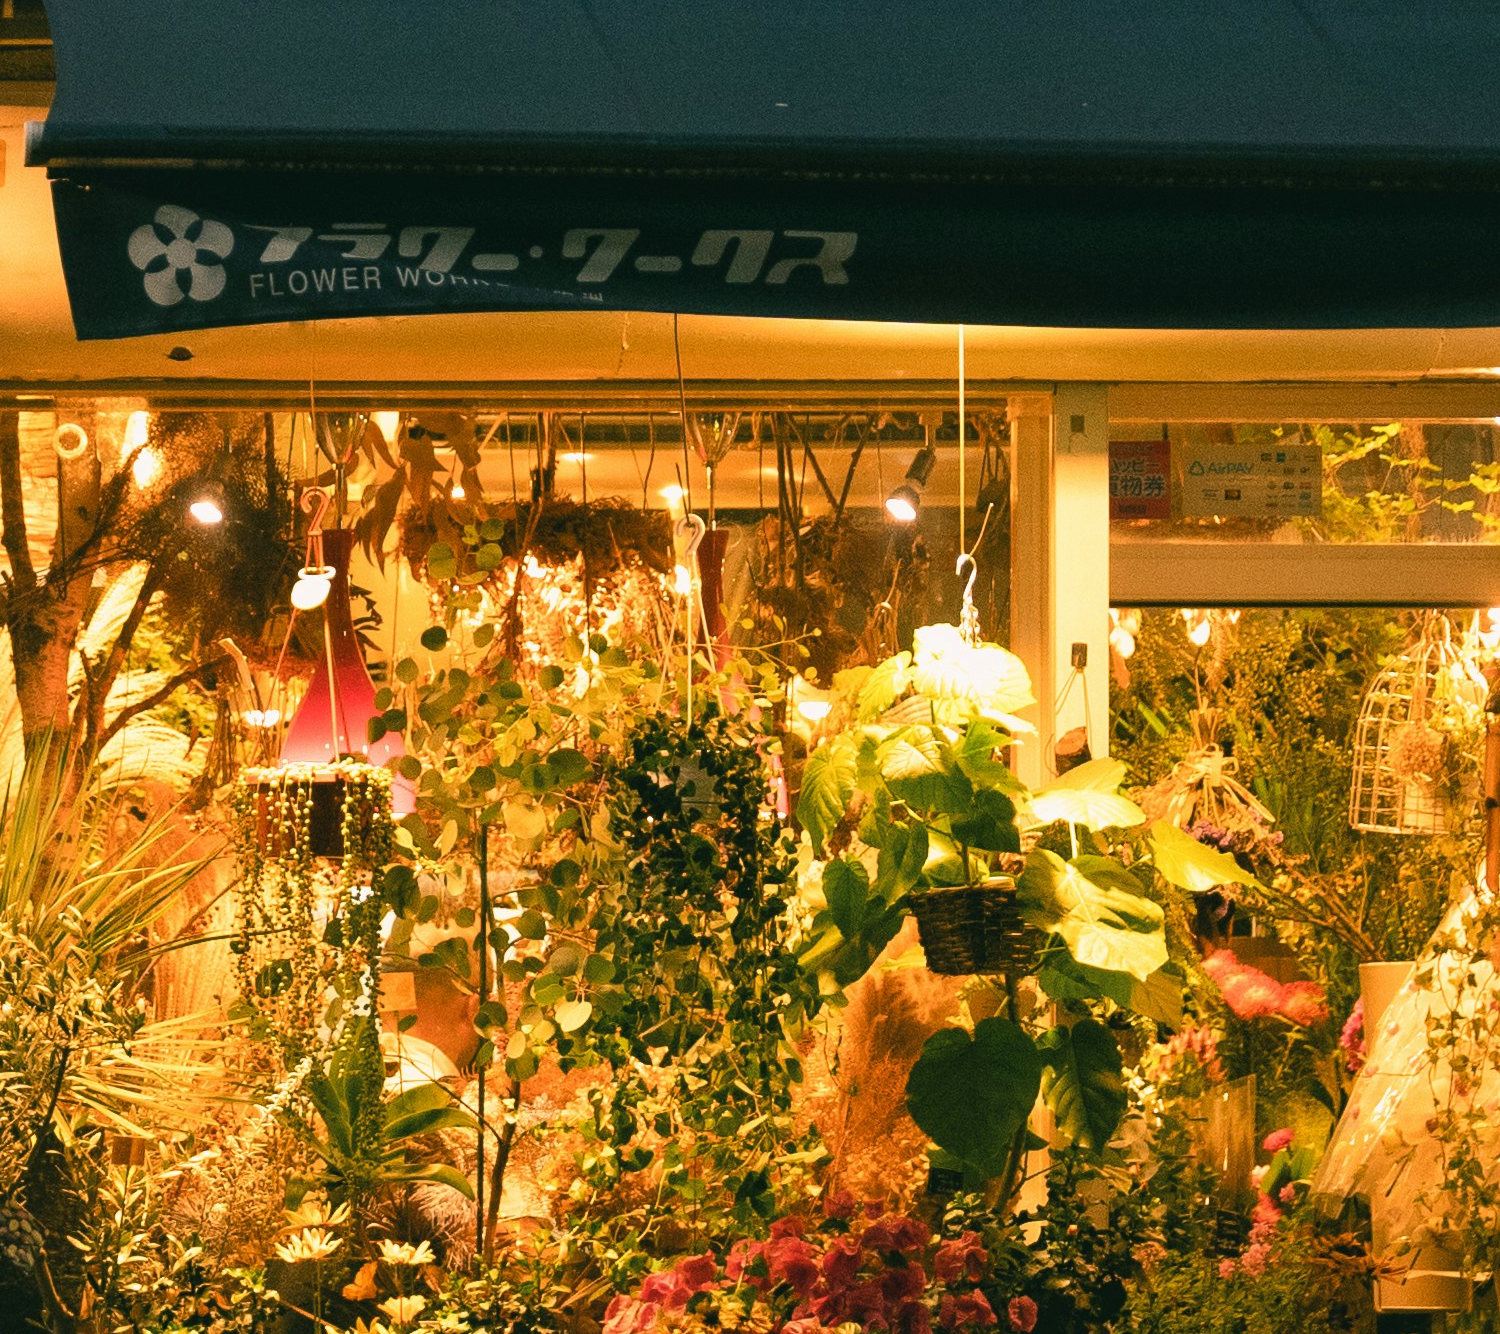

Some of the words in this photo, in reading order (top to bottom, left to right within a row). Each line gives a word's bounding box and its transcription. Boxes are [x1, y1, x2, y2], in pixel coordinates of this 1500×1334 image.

[241, 223, 857, 283] フラワー・ワークス
[250, 266, 381, 298] FLOWER
[1207, 462, 1254, 475] AirPAY
